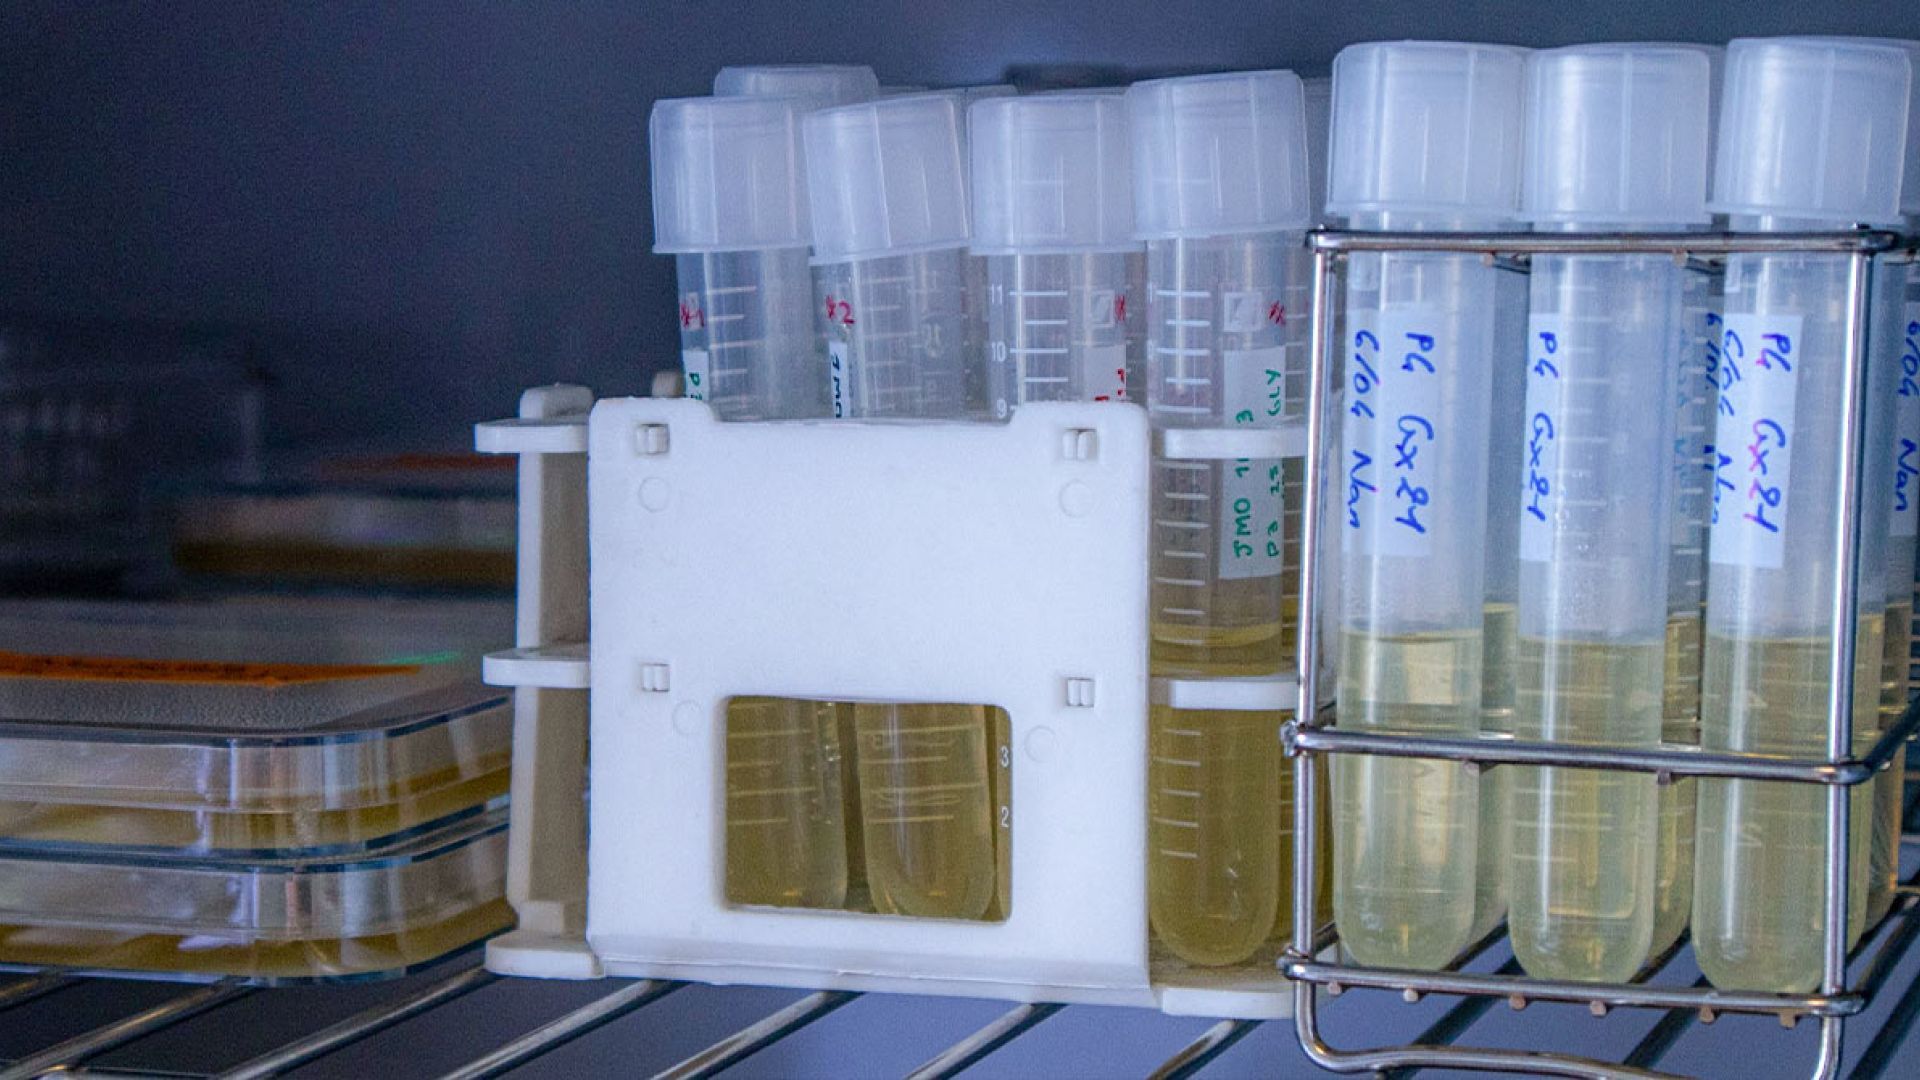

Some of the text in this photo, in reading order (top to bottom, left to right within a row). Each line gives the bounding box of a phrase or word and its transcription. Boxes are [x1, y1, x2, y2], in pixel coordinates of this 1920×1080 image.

[991, 342, 1006, 362] 10
[1266, 369, 1281, 416] GLY
[997, 399, 1007, 419] 9
[1234, 498, 1253, 558] JMO
[1000, 745, 1009, 767] 3
[1000, 806, 1010, 828] 2
